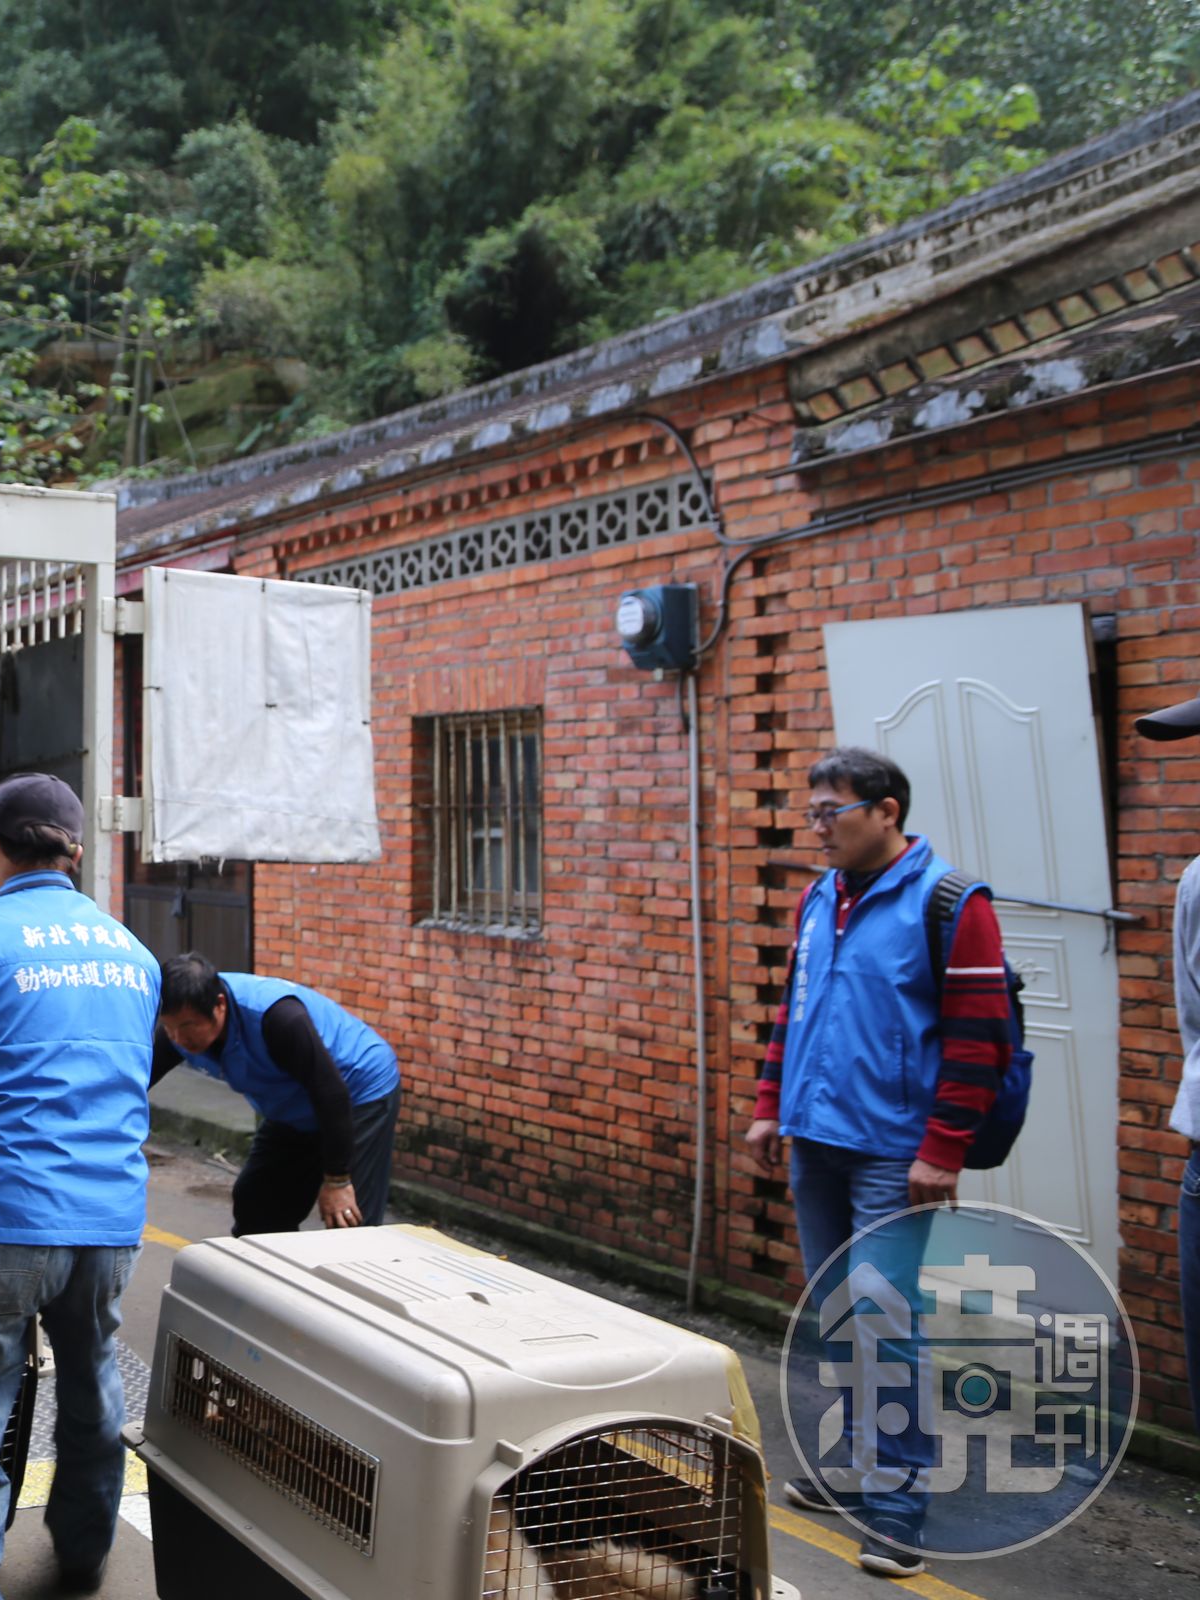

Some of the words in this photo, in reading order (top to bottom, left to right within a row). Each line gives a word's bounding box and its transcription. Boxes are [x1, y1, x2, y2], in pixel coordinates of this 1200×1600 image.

[22, 922, 132, 951] 新北市政府
[13, 961, 149, 996] 動物保護防疫處
